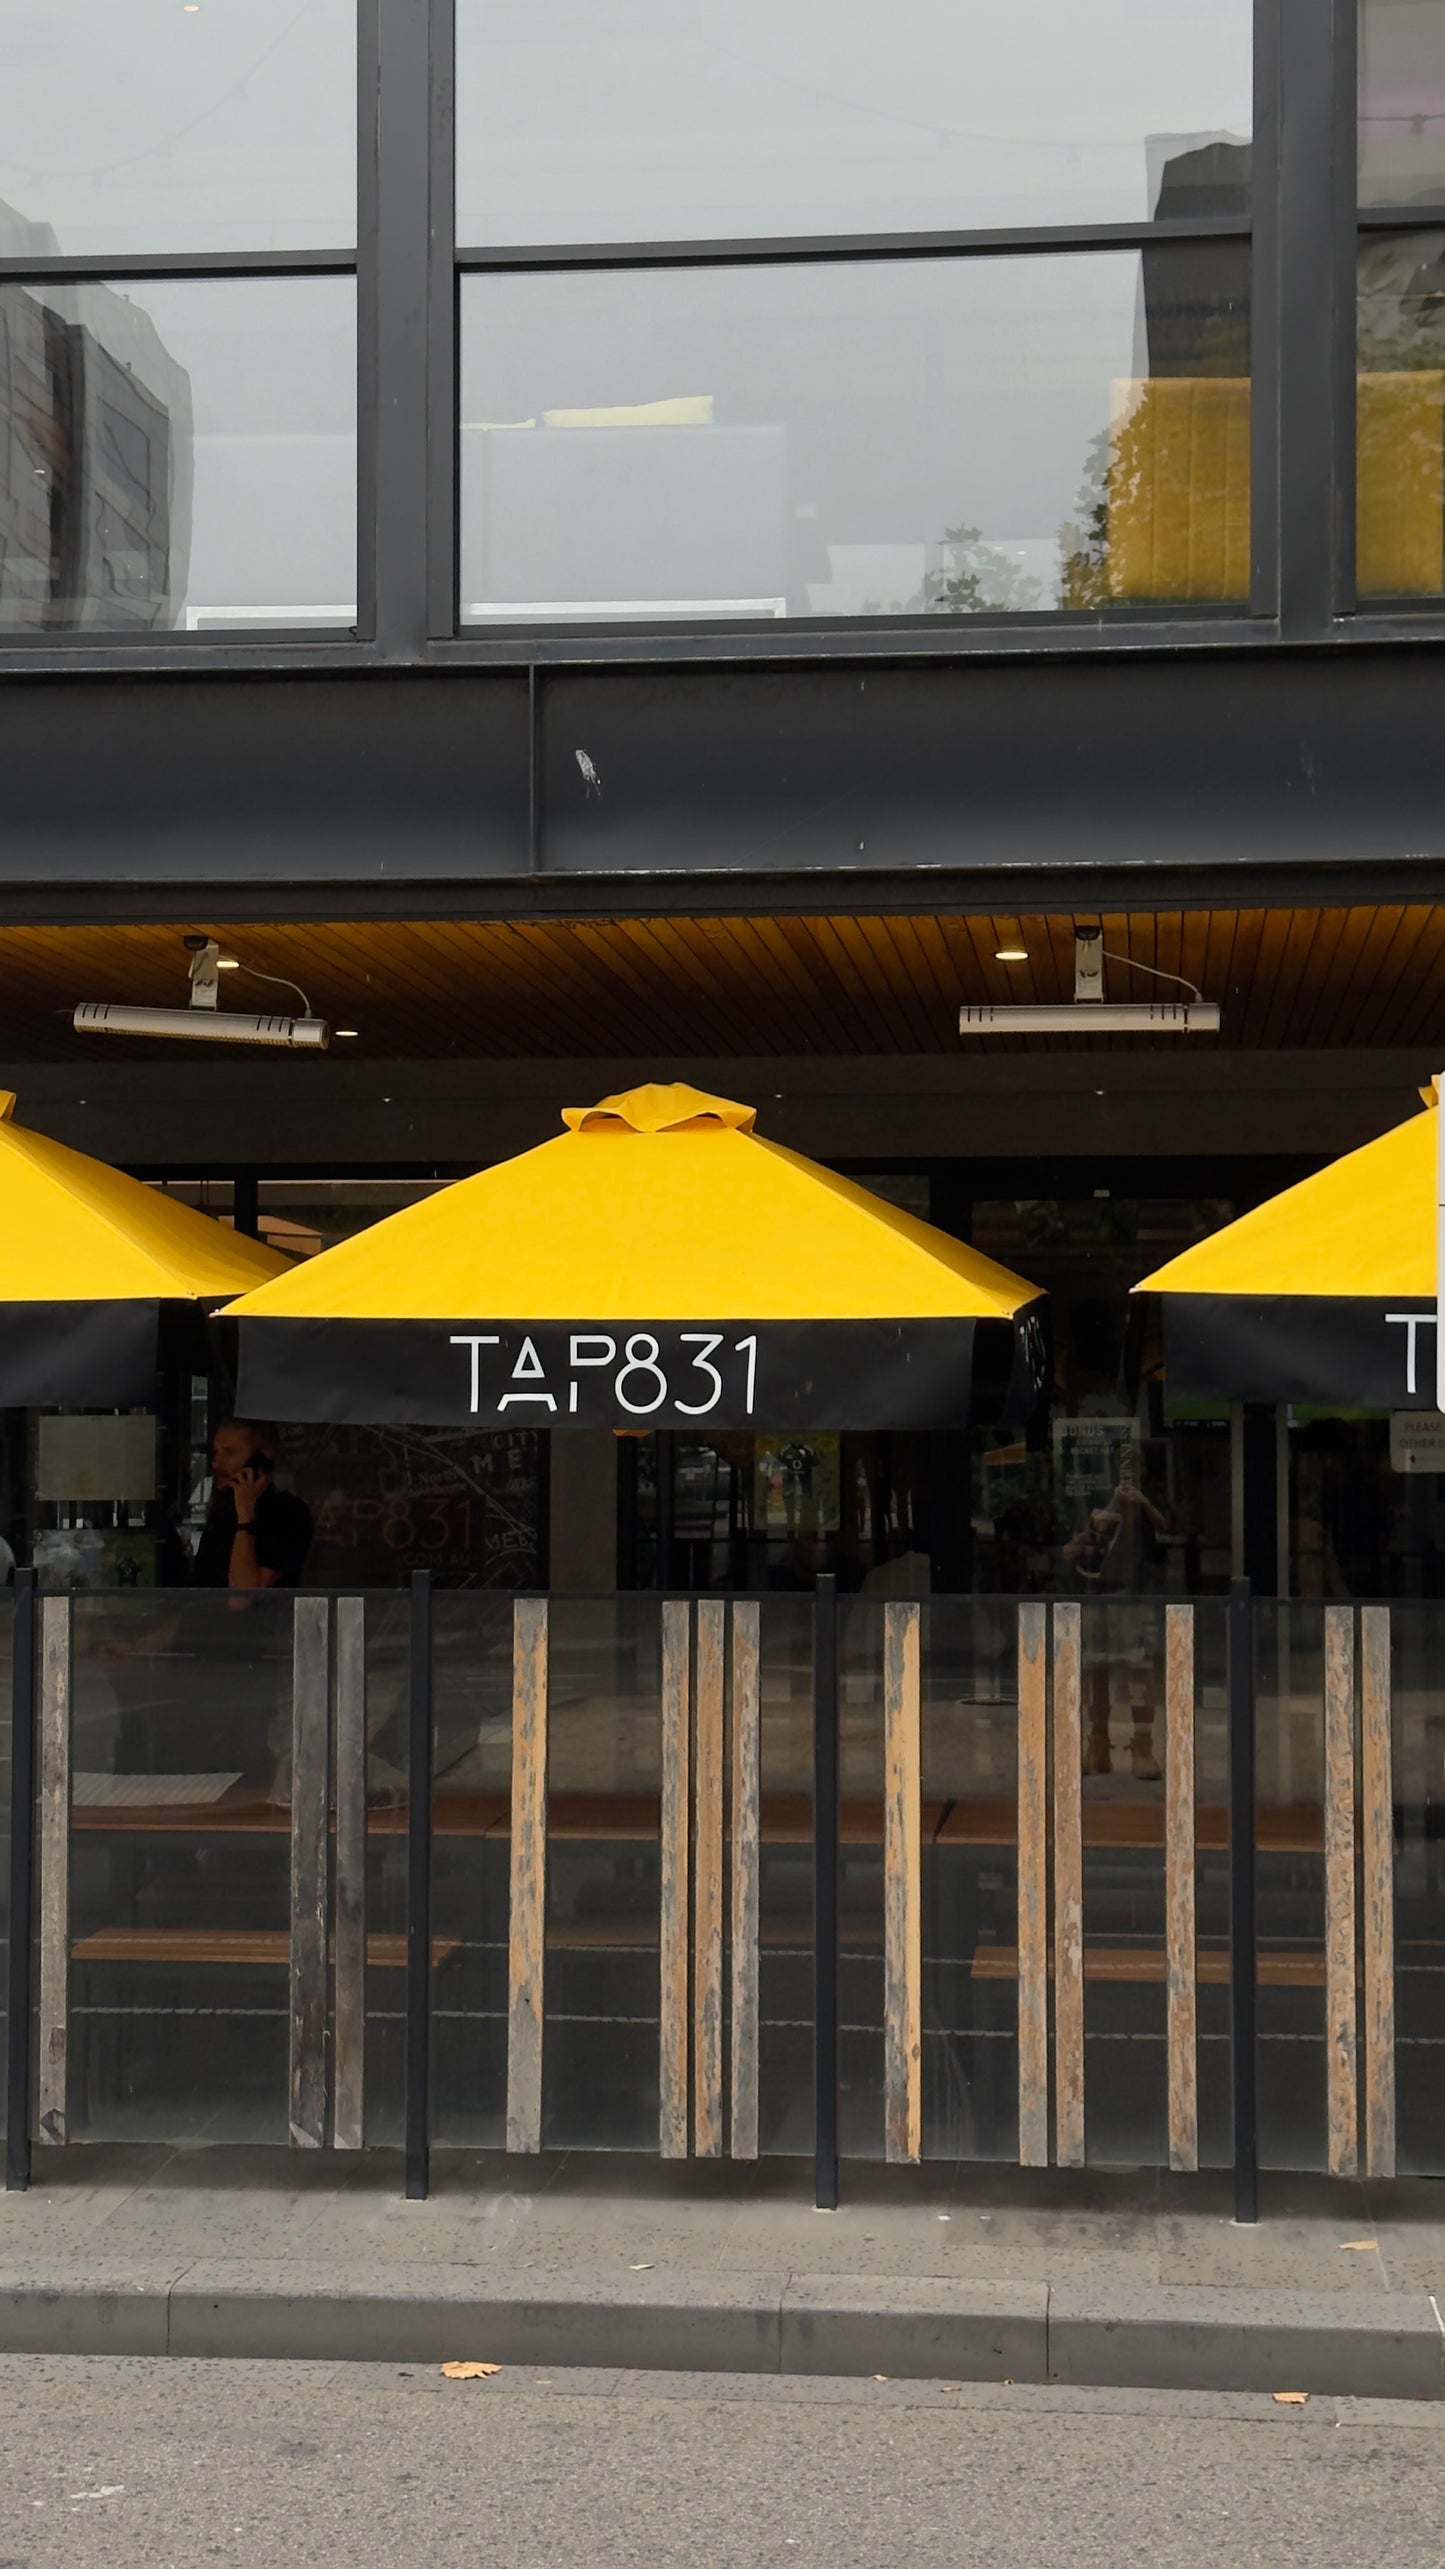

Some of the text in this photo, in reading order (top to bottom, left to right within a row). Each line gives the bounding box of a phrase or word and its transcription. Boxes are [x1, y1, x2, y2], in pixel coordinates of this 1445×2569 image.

[449, 1333, 757, 1416] TAP831
[1404, 1422, 1440, 1433] PLEASE
[1400, 1438, 1434, 1449] OTHER
[311, 1498, 471, 1550] AP831
